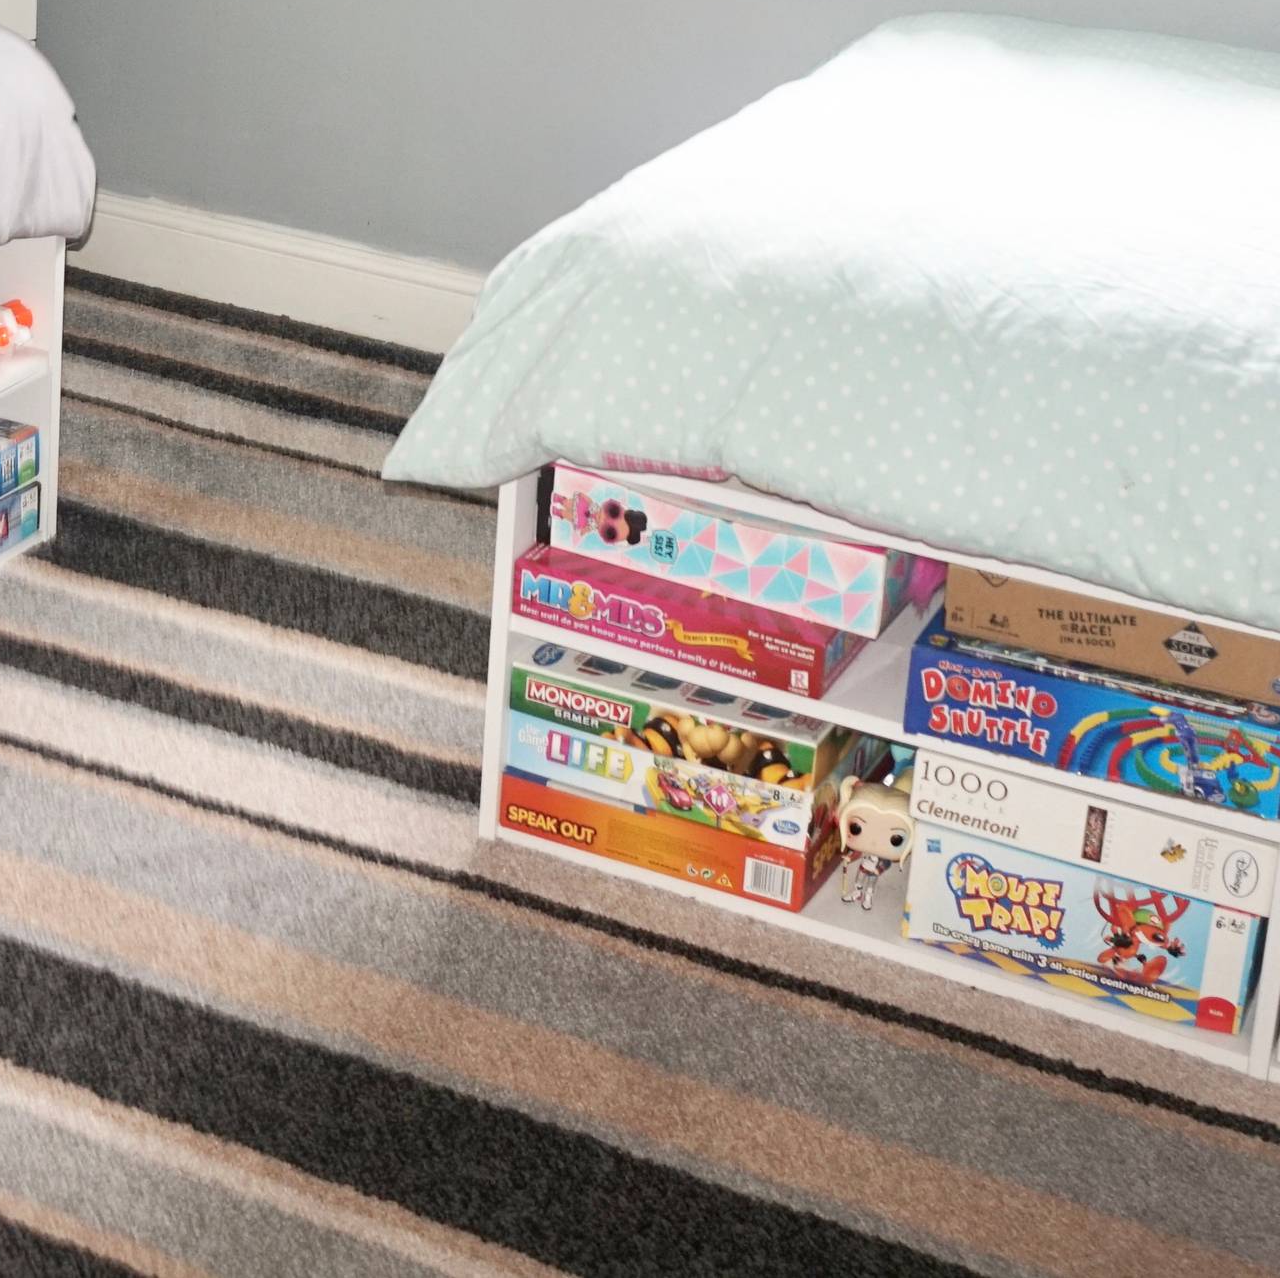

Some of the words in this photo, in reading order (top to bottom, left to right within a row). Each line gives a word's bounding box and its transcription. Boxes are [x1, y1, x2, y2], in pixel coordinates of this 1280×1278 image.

[1037, 607, 1065, 620] THE
[1068, 610, 1137, 627] ULTIMATE
[1070, 623, 1112, 637] RACE!
[520, 604, 538, 616] How
[540, 611, 559, 621] well
[560, 616, 571, 625] do
[573, 622, 590, 631] you
[591, 625, 616, 638] know
[617, 632, 638, 643] your
[639, 640, 675, 657] partner,
[677, 649, 707, 666] family
[719, 661, 757, 679] friends?
[1171, 641, 1211, 658] SOCK
[1182, 632, 1201, 643] THE
[1175, 653, 1203, 666] GAME
[529, 682, 629, 723] MONOPOLY
[921, 667, 1058, 718] DOMINO
[554, 709, 600, 729] GAMER
[928, 704, 1050, 757] SHUTTLE
[550, 732, 626, 780] LIFE
[921, 761, 1009, 802] 1000
[508, 805, 558, 834] SPEAK
[559, 821, 595, 844] OUT
[916, 799, 1020, 839] Clementoni
[965, 863, 1062, 907] MOUSE
[1229, 856, 1253, 894] Disney
[960, 898, 1063, 941] TRAP!
[933, 922, 950, 936] the
[951, 931, 981, 948] crazy
[982, 940, 1010, 955] game
[1012, 950, 1034, 963] with
[1037, 955, 1048, 968] 3
[1049, 961, 1098, 982] all-action
[1099, 977, 1171, 1003] contraptions!
